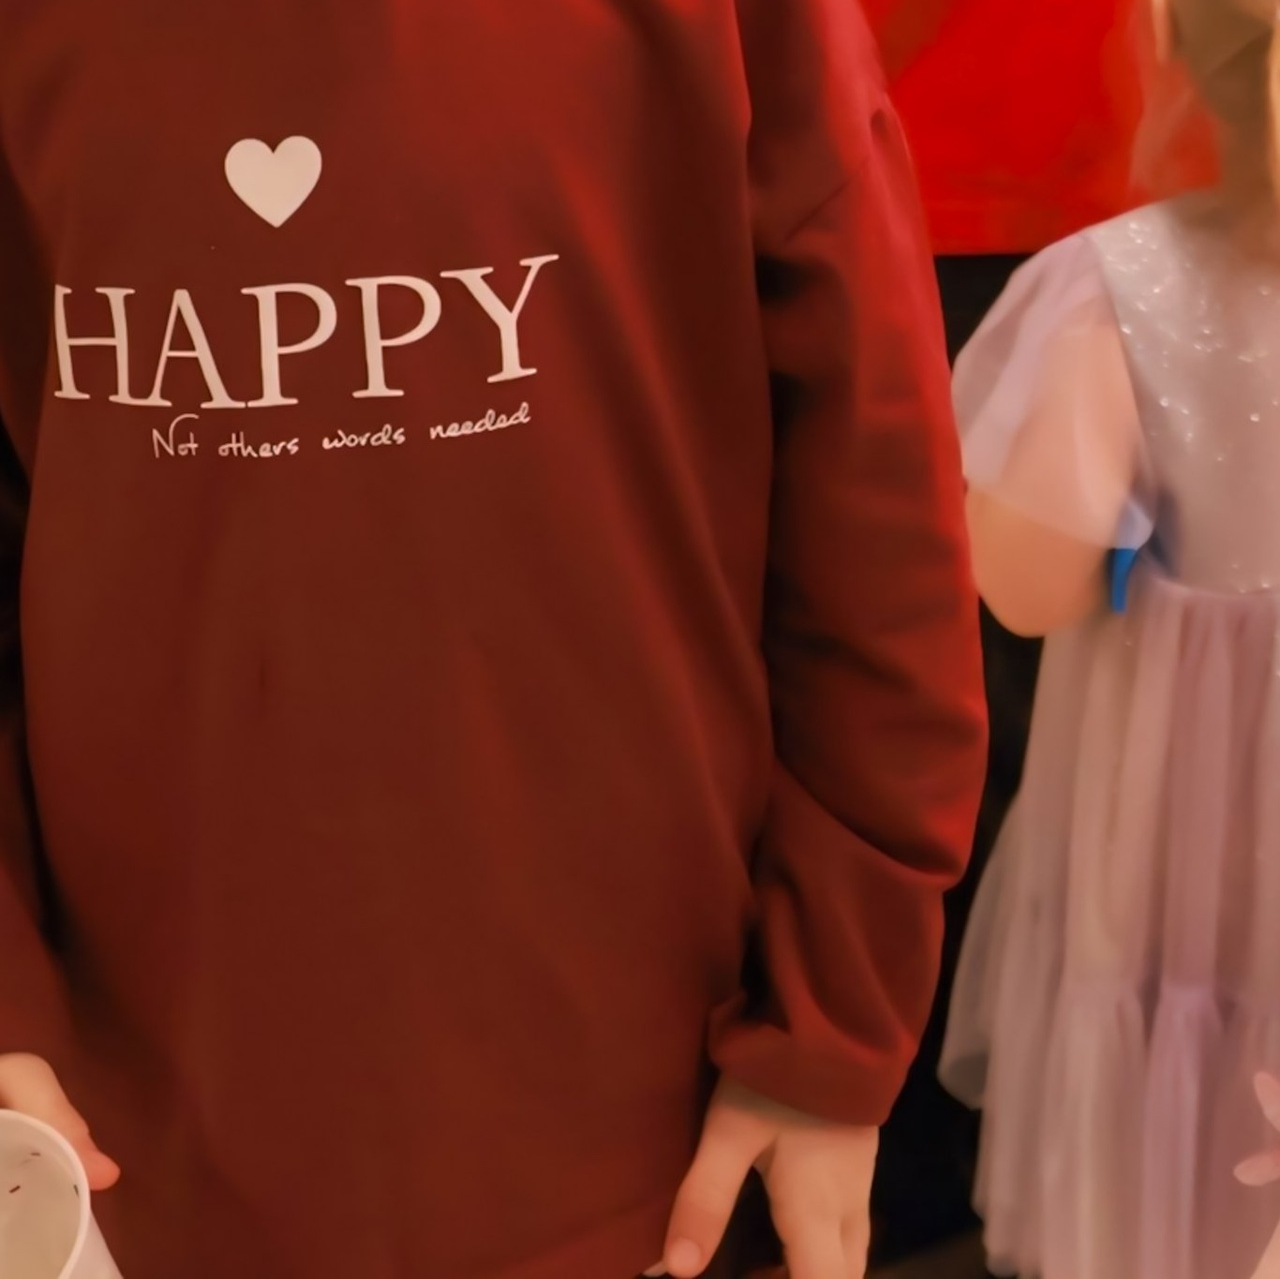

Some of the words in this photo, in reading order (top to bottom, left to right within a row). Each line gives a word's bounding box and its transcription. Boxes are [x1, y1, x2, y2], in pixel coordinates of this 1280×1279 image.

[54, 253, 560, 409] HAPPY
[218, 431, 299, 458] others
[322, 424, 406, 450] words
[429, 401, 531, 440] needed
